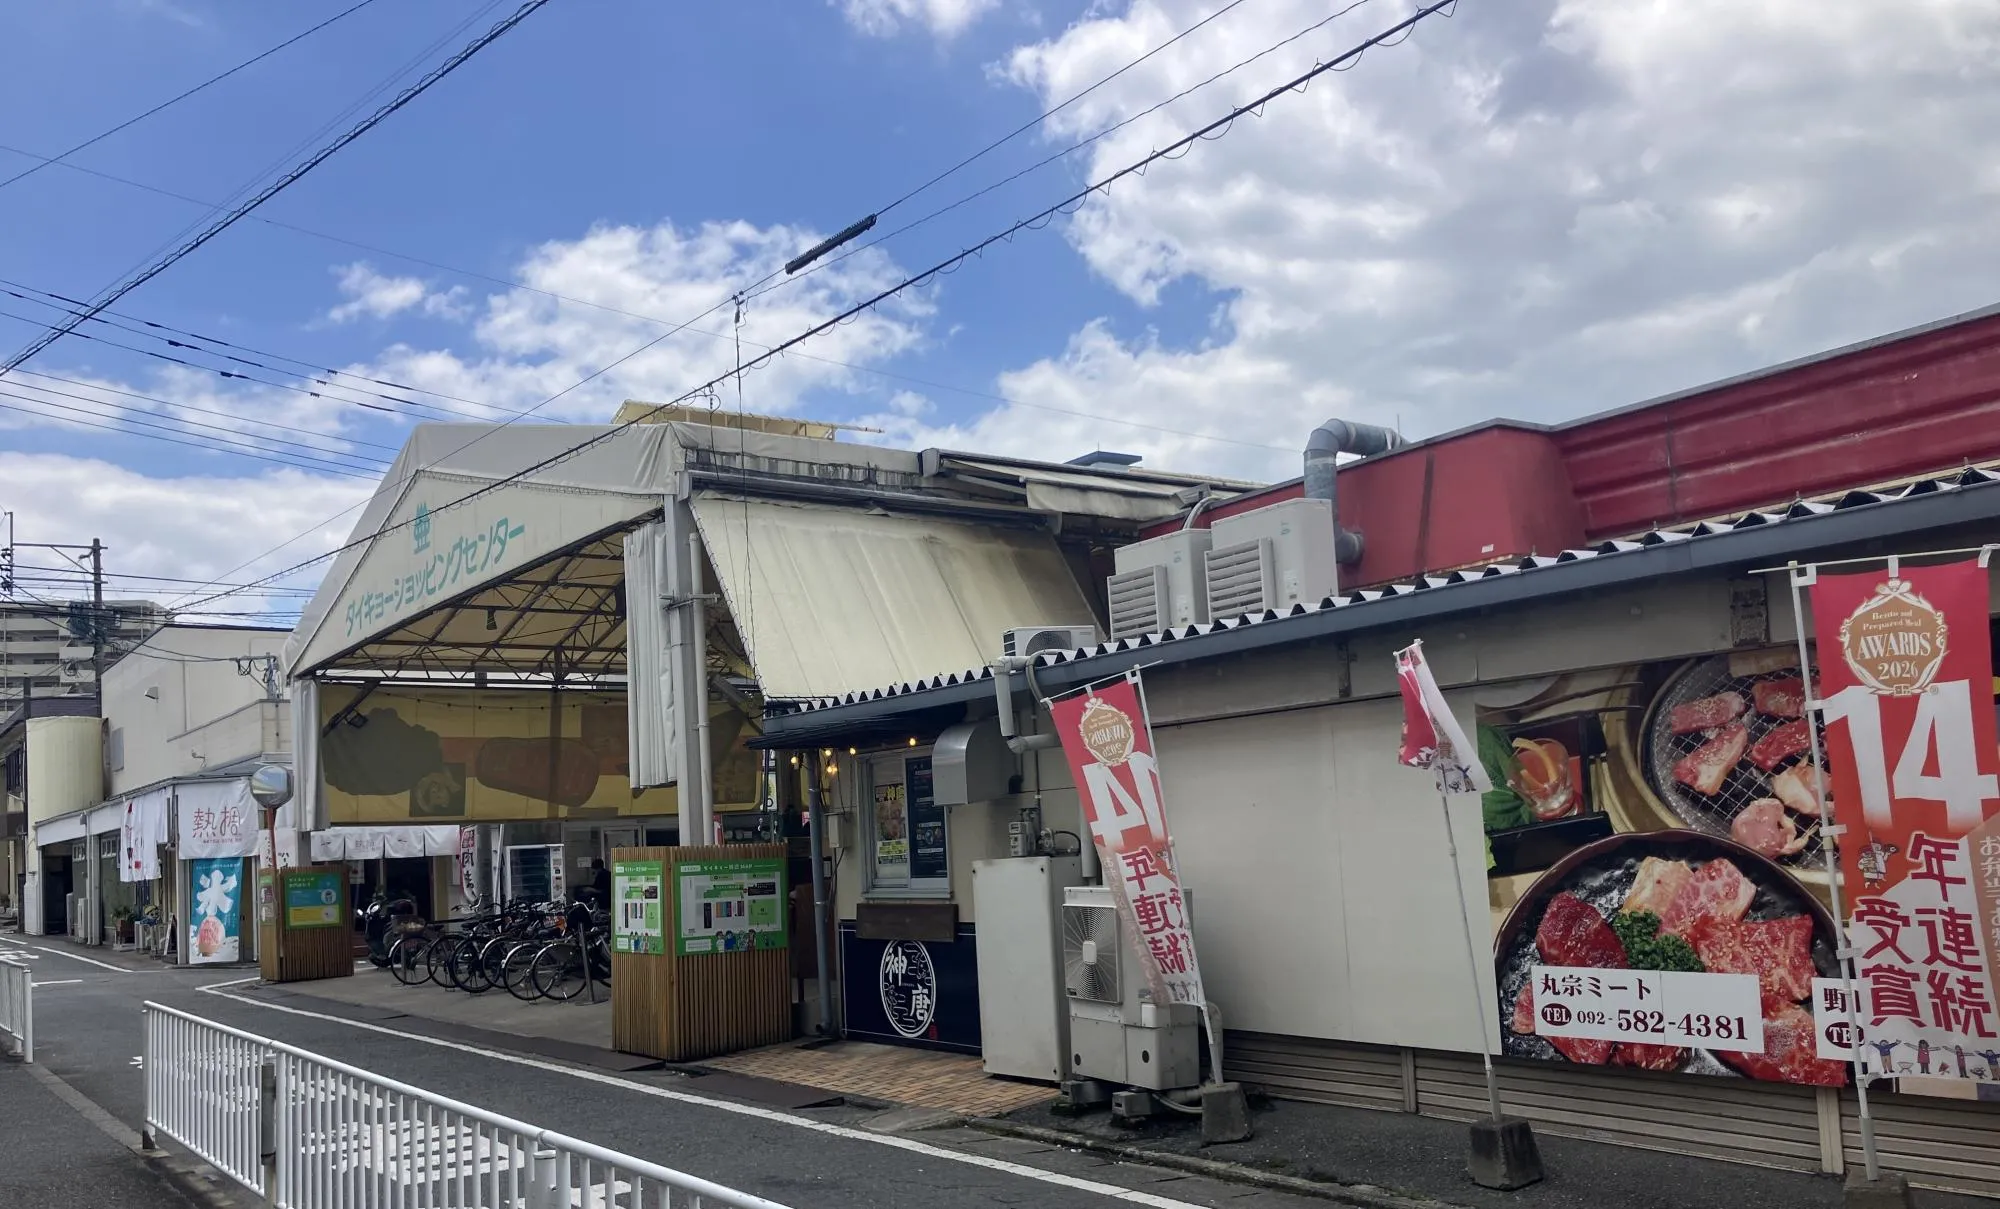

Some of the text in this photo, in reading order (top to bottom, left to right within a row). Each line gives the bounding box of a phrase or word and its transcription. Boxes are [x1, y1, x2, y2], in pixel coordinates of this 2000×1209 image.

[1863, 618, 1921, 631] Prepared Meal
[1872, 612, 1898, 620] Bento
[1857, 631, 1931, 660] AWARDS
[1878, 661, 1918, 680] 2026
[1823, 679, 2000, 830] 14
[195, 869, 238, 916] 氷
[1906, 831, 1998, 1039] 年連続
[1855, 897, 1926, 1029] 受賞
[1541, 972, 1652, 1001] 丸宗ミート
[1543, 1006, 1749, 1042] TEL 092-582-4381
